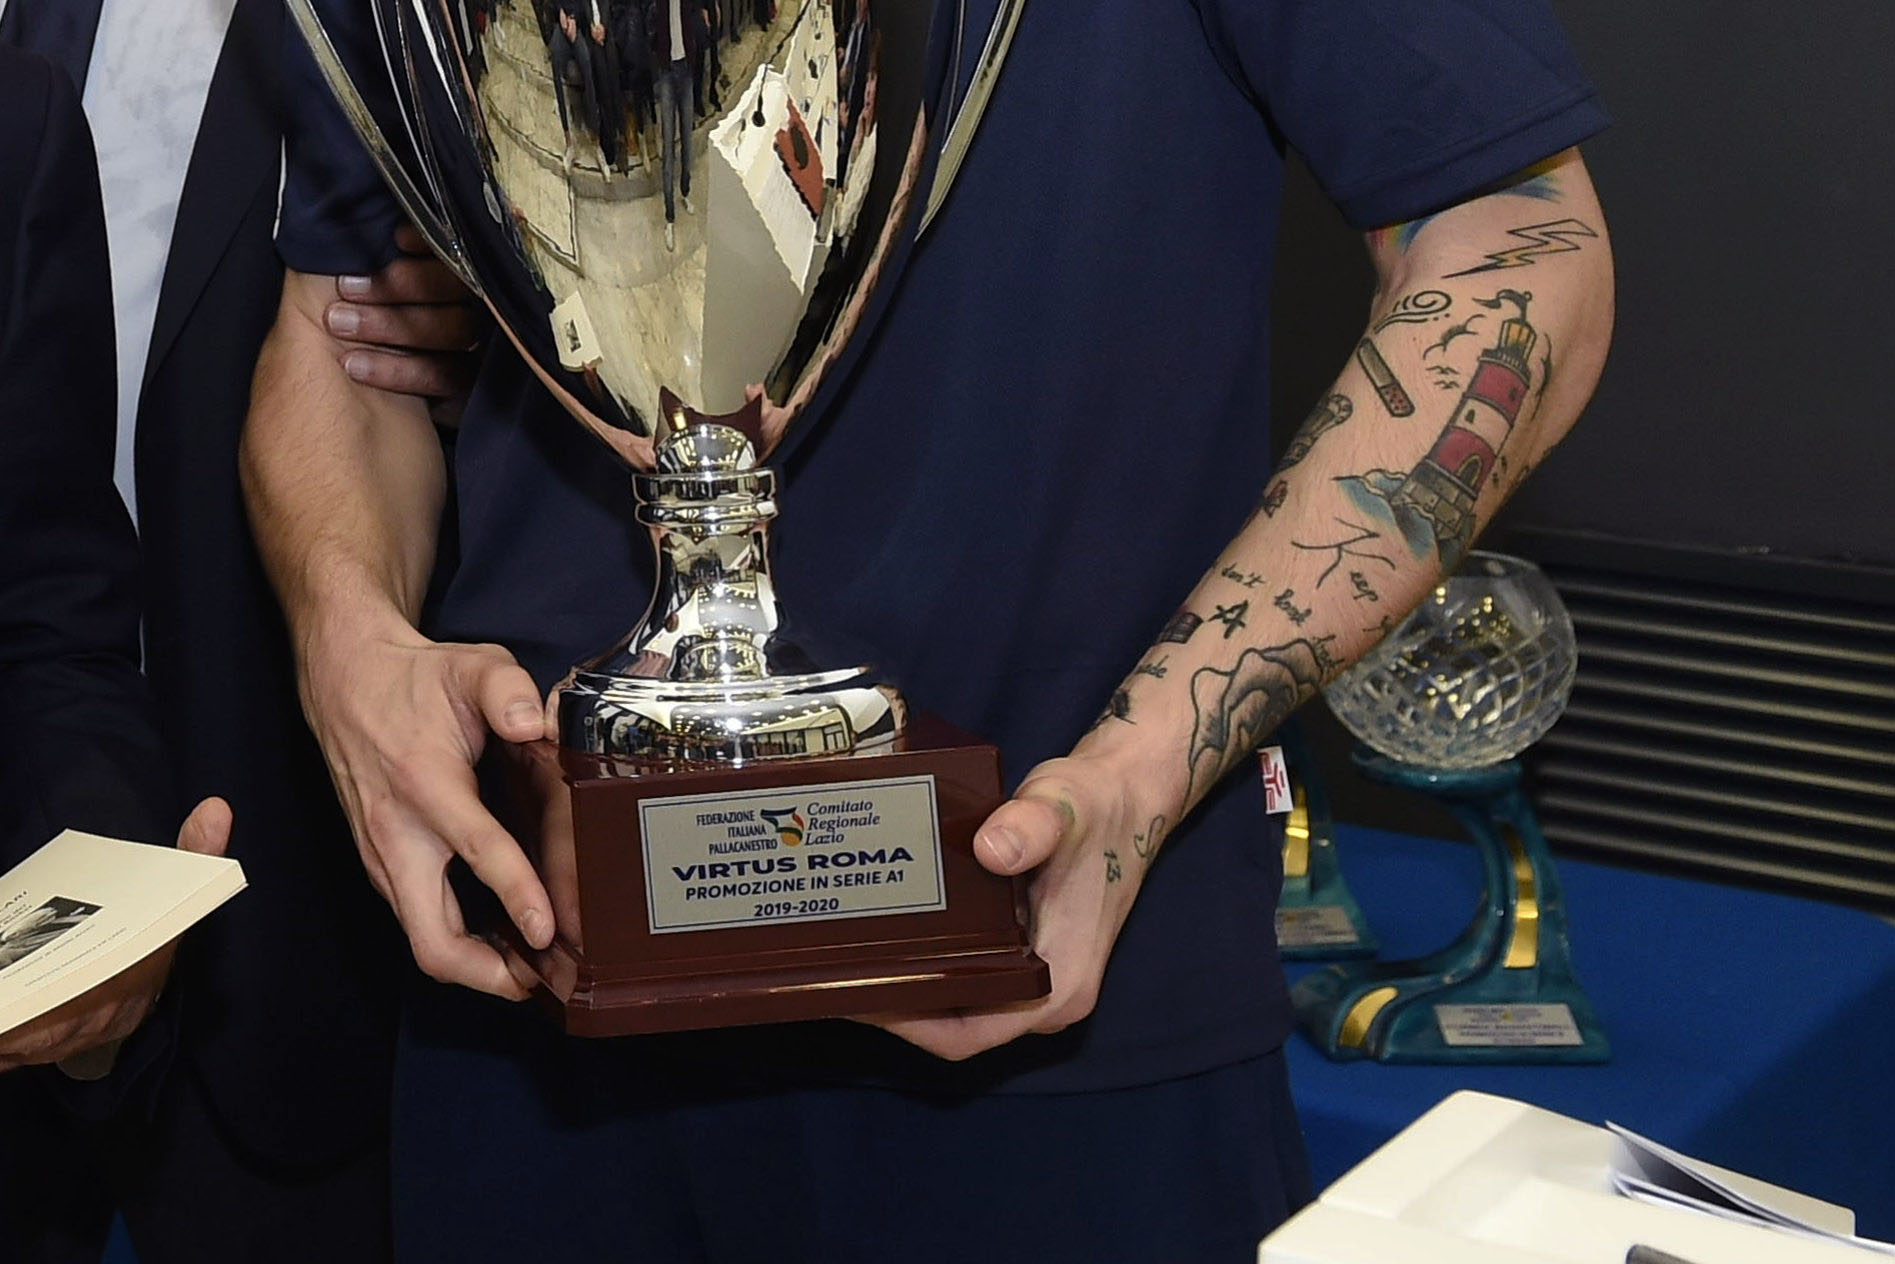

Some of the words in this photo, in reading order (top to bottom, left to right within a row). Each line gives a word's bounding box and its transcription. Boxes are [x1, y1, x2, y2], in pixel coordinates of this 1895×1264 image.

[1221, 563, 1265, 590] don't
[807, 799, 873, 816] Comitato
[696, 810, 755, 828] FEDERAZIONE
[808, 813, 881, 832] Regionale
[728, 825, 766, 838] ITALIANA
[805, 831, 845, 846] Lazio
[709, 838, 777, 855] PALLACANESTRO
[672, 856, 797, 882] VIRTUS
[807, 847, 914, 871] ROMA
[685, 878, 805, 901] PROMOZIONE
[811, 876, 829, 890] IN
[833, 872, 882, 888] SERIE
[886, 869, 905, 884] A1
[754, 898, 839, 917] 2019-2020
